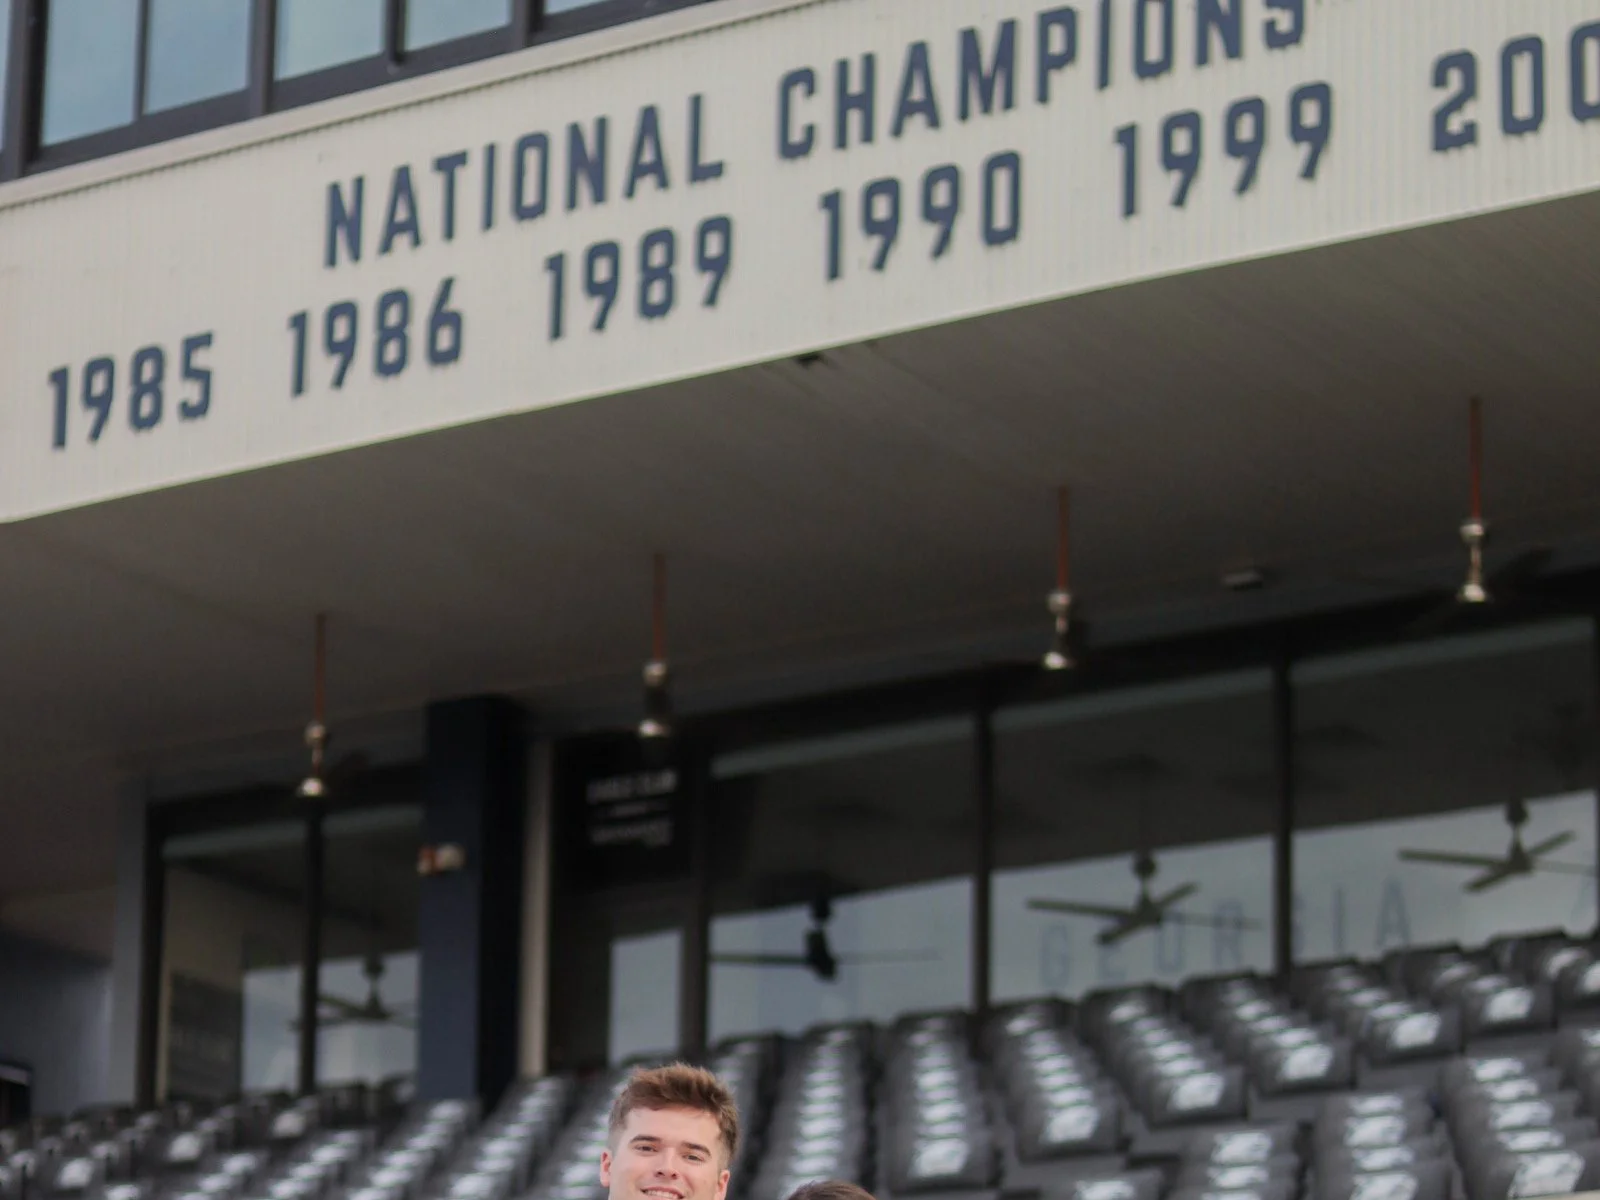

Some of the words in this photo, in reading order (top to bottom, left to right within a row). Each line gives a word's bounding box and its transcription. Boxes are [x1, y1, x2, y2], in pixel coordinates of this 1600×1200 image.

[49, 332, 213, 449] 1985
[290, 277, 462, 397] 1986
[545, 216, 732, 340] 1989
[821, 151, 1021, 281] 1990
[1115, 82, 1332, 219] 1999
[326, 94, 724, 268] NATIONAL
